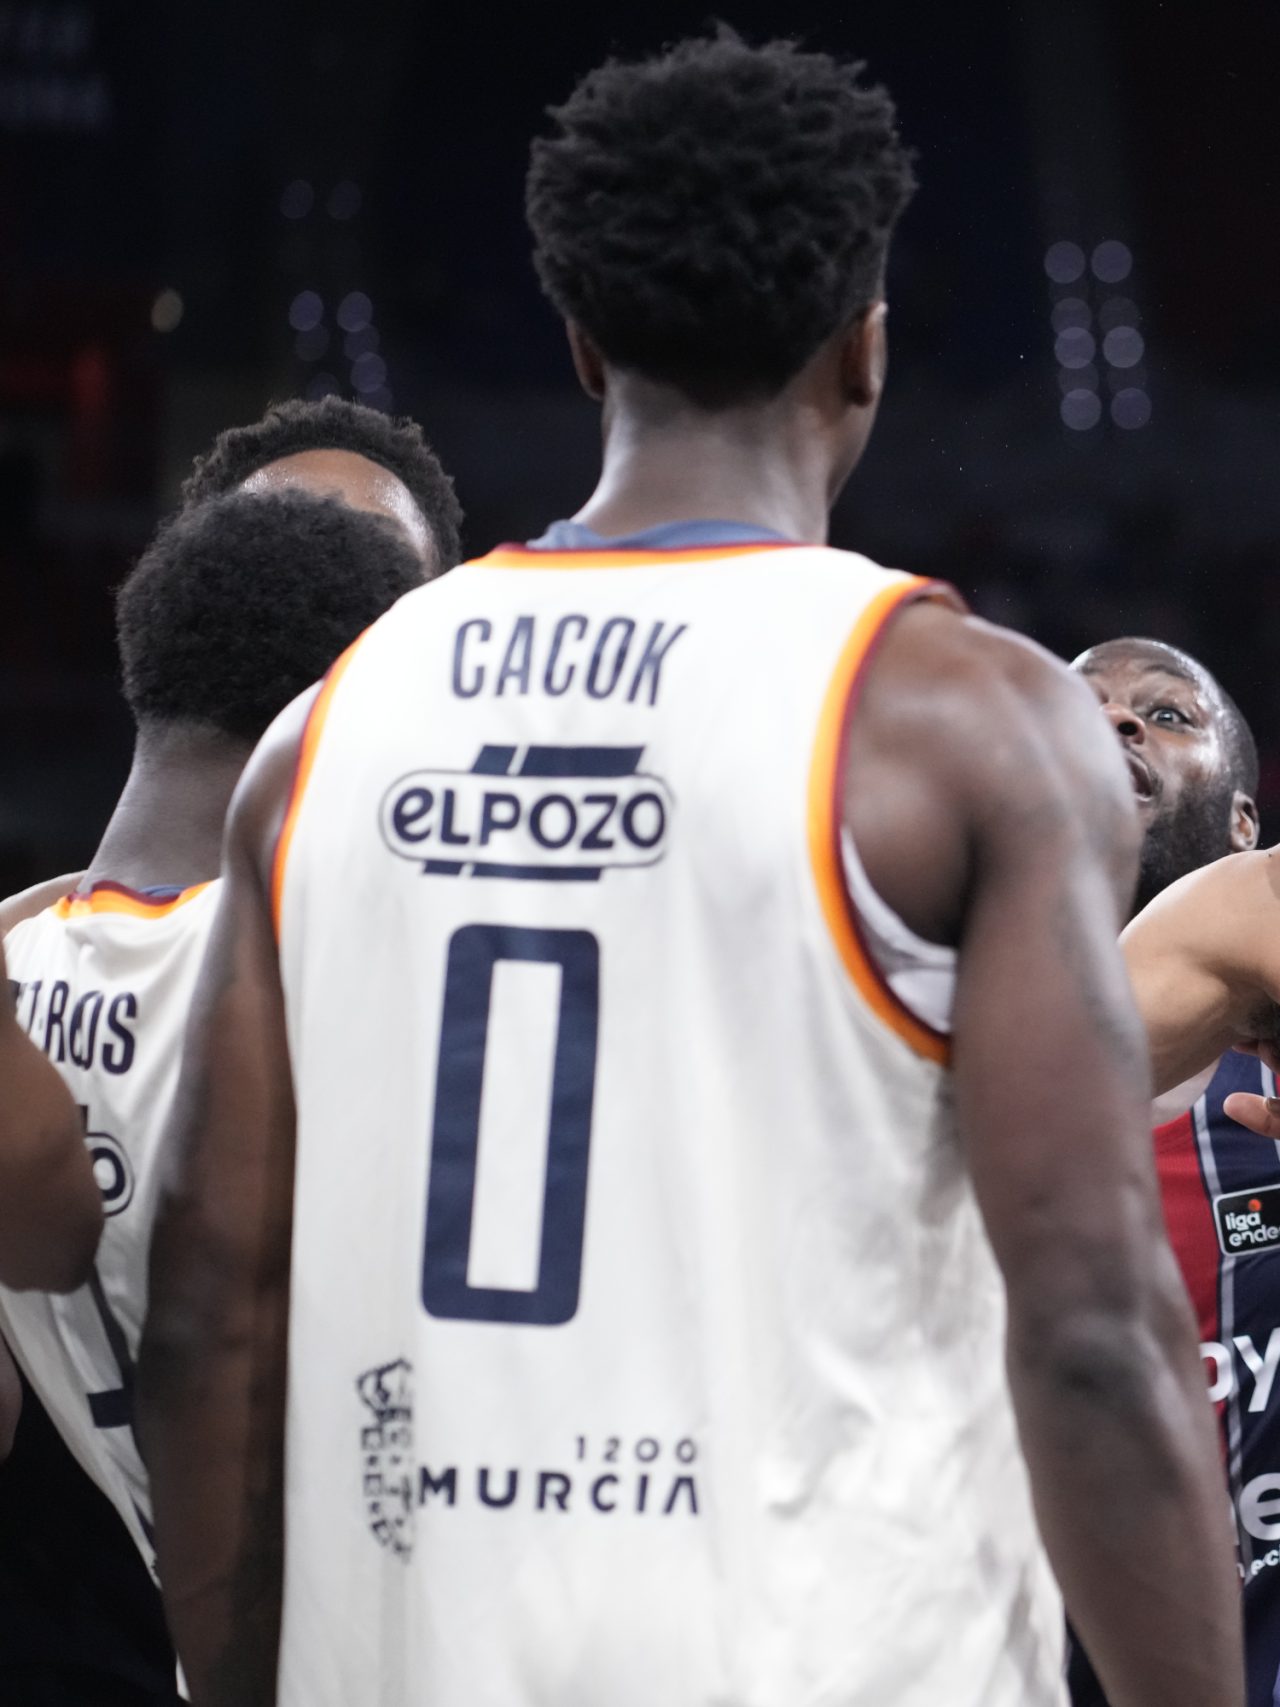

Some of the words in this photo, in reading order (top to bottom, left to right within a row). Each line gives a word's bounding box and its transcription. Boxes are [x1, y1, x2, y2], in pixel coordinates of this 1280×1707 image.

[452, 614, 688, 706] CACOK
[420, 923, 601, 1326] 0
[1225, 1212, 1261, 1231] liga
[576, 1436, 698, 1464] 1200
